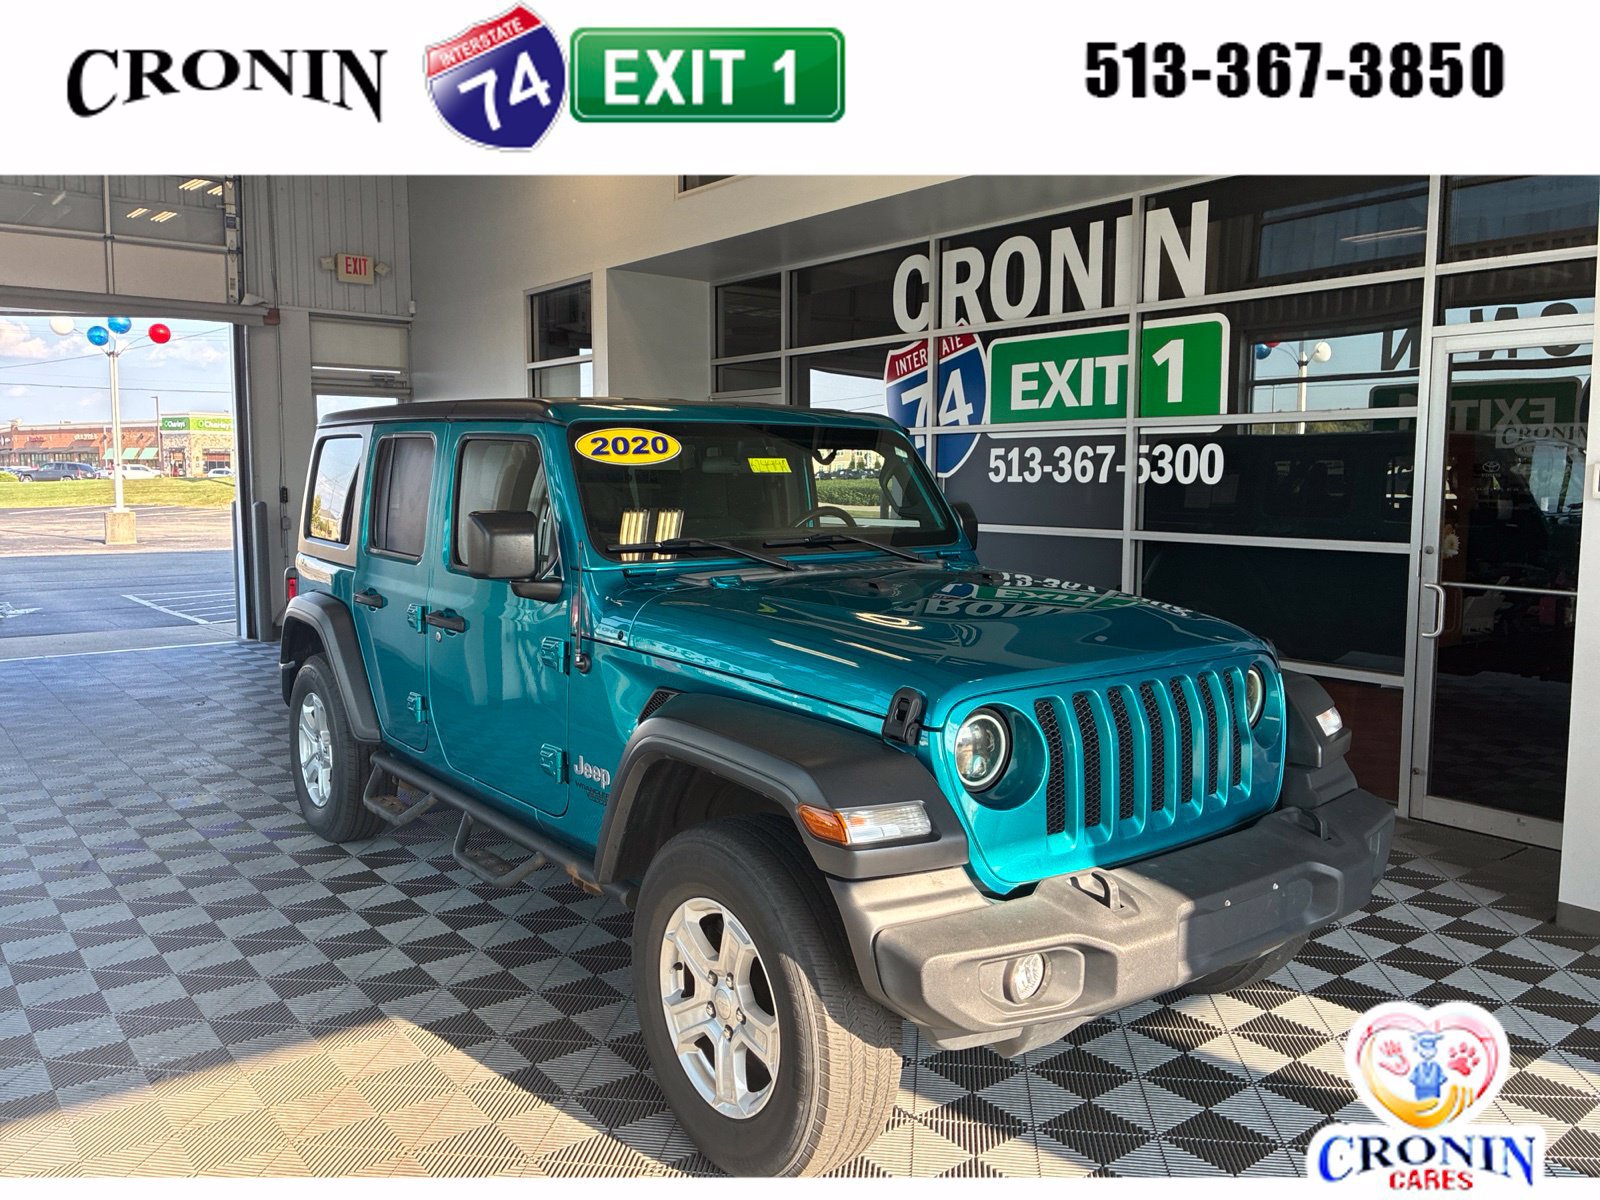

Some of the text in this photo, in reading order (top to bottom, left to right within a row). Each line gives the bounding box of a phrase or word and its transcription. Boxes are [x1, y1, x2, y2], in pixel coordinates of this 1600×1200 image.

[345, 256, 368, 276] EXIT
[893, 200, 1209, 333] CRONIN
[895, 335, 964, 377] INTERATE
[1010, 339, 1185, 412] EXIT 1
[901, 368, 974, 449] 74
[591, 436, 669, 456] 2020
[1502, 426, 1587, 446] CRONIN
[988, 443, 1224, 485] 513-367-5300
[574, 755, 611, 790] Jeep
